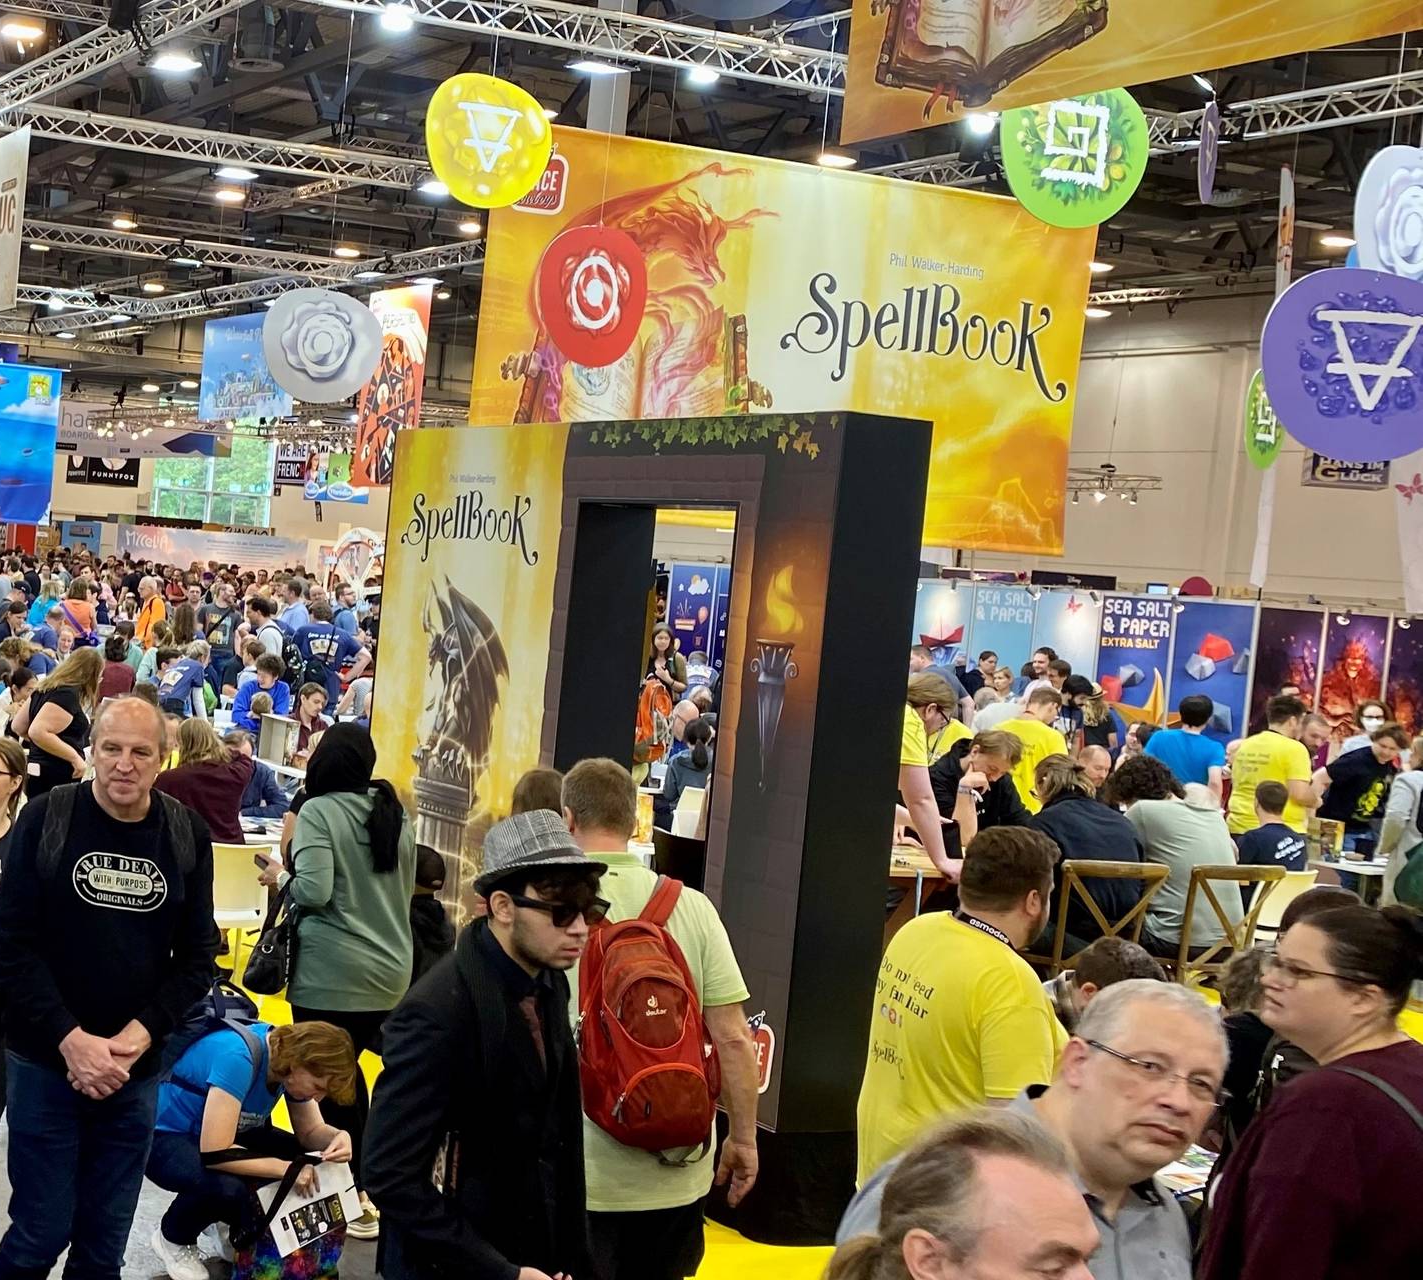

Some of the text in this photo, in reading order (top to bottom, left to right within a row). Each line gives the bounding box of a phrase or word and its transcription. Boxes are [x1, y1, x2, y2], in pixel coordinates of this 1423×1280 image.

[890, 253, 985, 280] Phil Walker-Harding
[92, 471, 135, 481] FUNNYFOX
[978, 590, 1001, 604] SEA
[976, 606, 1034, 624] & PAPER
[1105, 599, 1173, 618] SEA SALT
[1103, 616, 1171, 637] & PAPER
[1102, 636, 1160, 649] EXTRA SALT
[76, 855, 164, 893] TRUE DENIM
[93, 874, 148, 890] WITH PURPOSE
[96, 892, 144, 906] ORIGINALS
[969, 917, 1010, 944] asmodee
